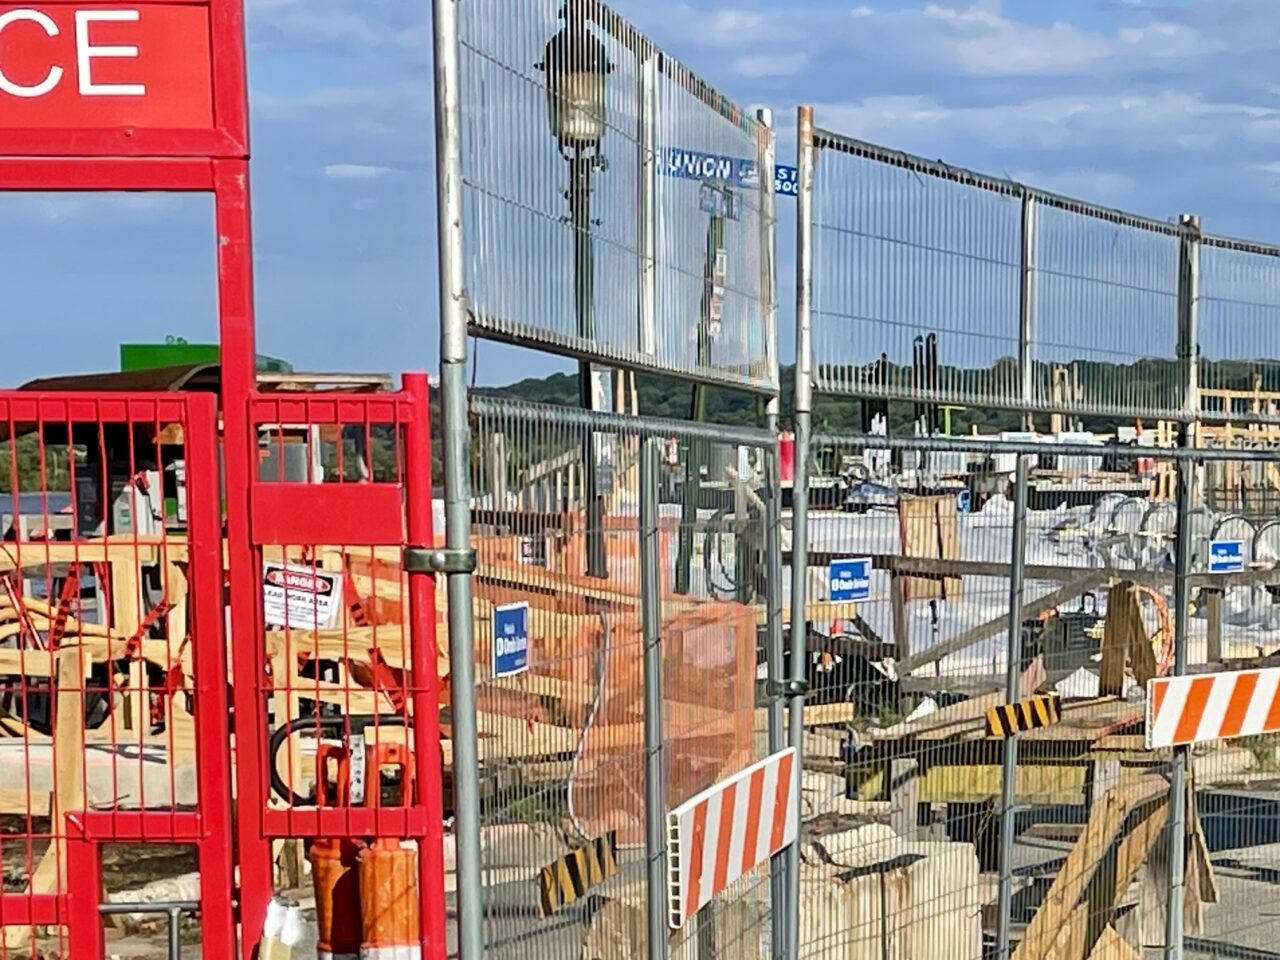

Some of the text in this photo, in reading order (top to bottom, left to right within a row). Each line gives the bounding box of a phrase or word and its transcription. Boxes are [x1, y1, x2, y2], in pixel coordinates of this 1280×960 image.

[0, 8, 146, 98] CE
[669, 150, 731, 180] UNION
[275, 571, 324, 592] DANGER
[308, 598, 329, 607] AEA
